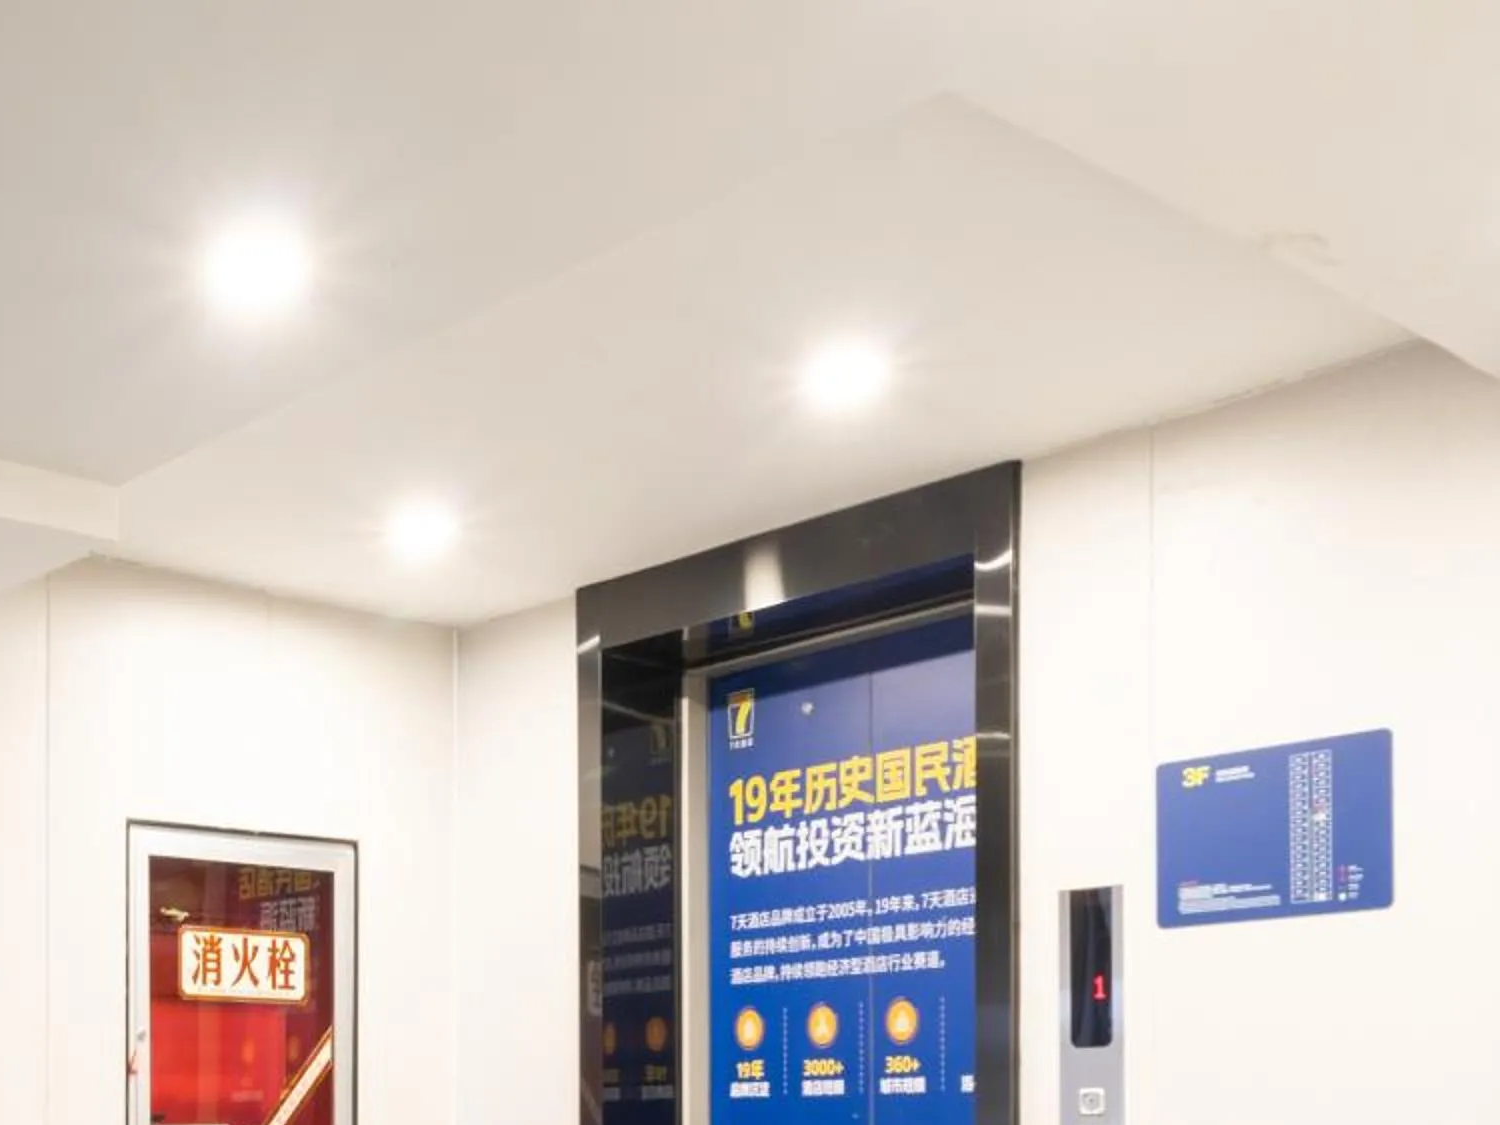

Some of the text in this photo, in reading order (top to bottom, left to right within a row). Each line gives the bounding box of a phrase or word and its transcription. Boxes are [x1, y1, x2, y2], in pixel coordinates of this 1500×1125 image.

[192, 934, 297, 991] 消火栓
[1093, 975, 1107, 999] 1
